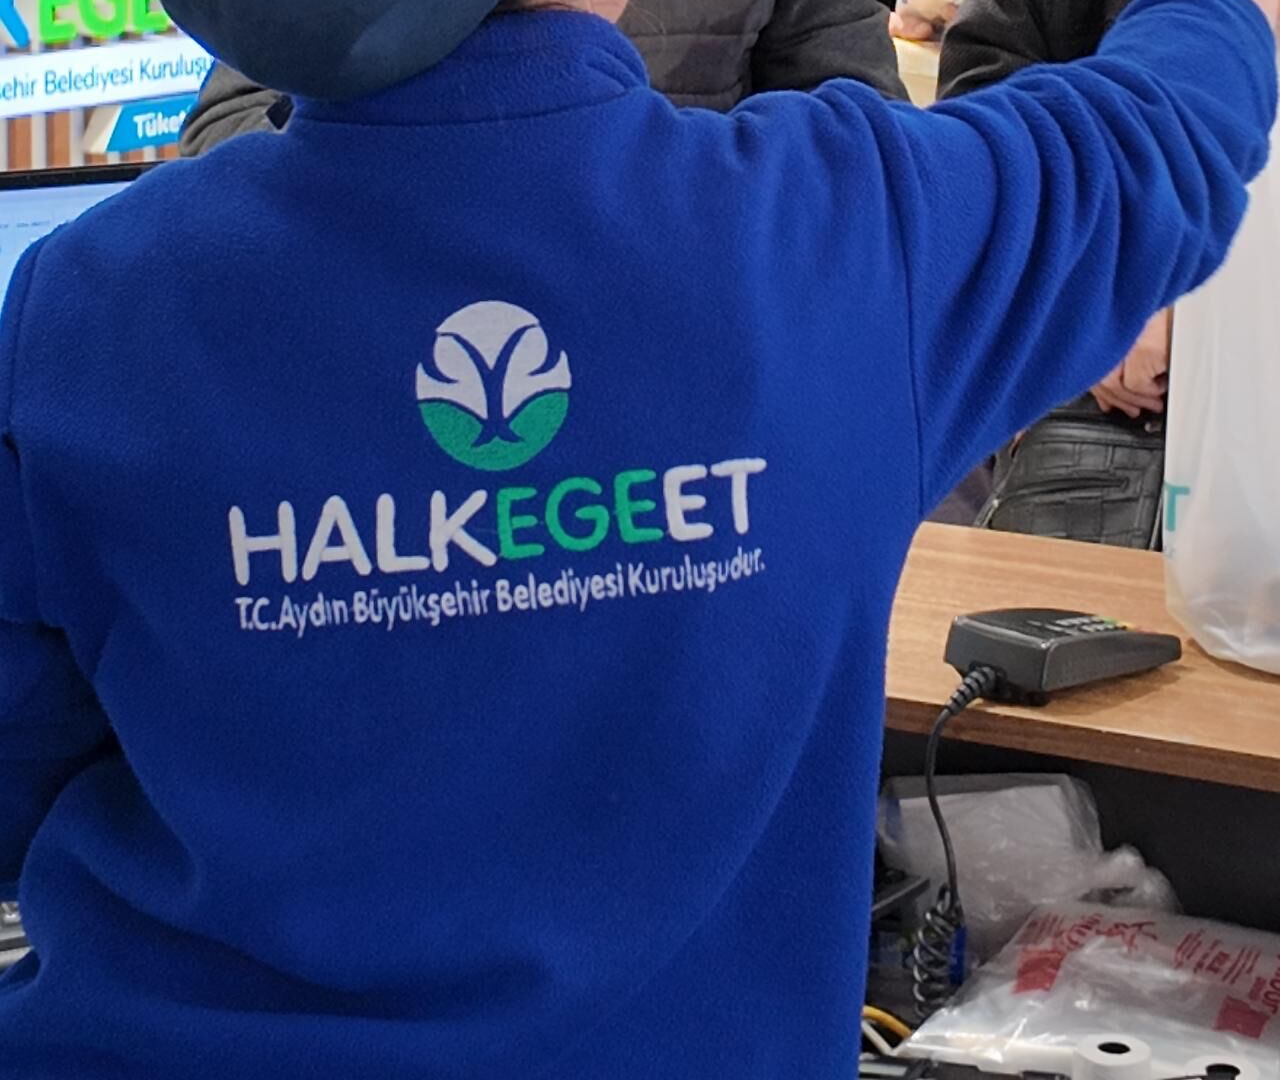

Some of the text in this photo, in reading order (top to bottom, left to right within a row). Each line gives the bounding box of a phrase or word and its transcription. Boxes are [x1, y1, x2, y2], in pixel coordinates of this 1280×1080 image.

[45, 58, 133, 94] Belediyesi
[228, 457, 767, 586] HALKEGEET
[352, 579, 491, 632] Büyükşehir
[495, 561, 624, 612] Belediyesi
[628, 545, 766, 597] Kuruluşudur.
